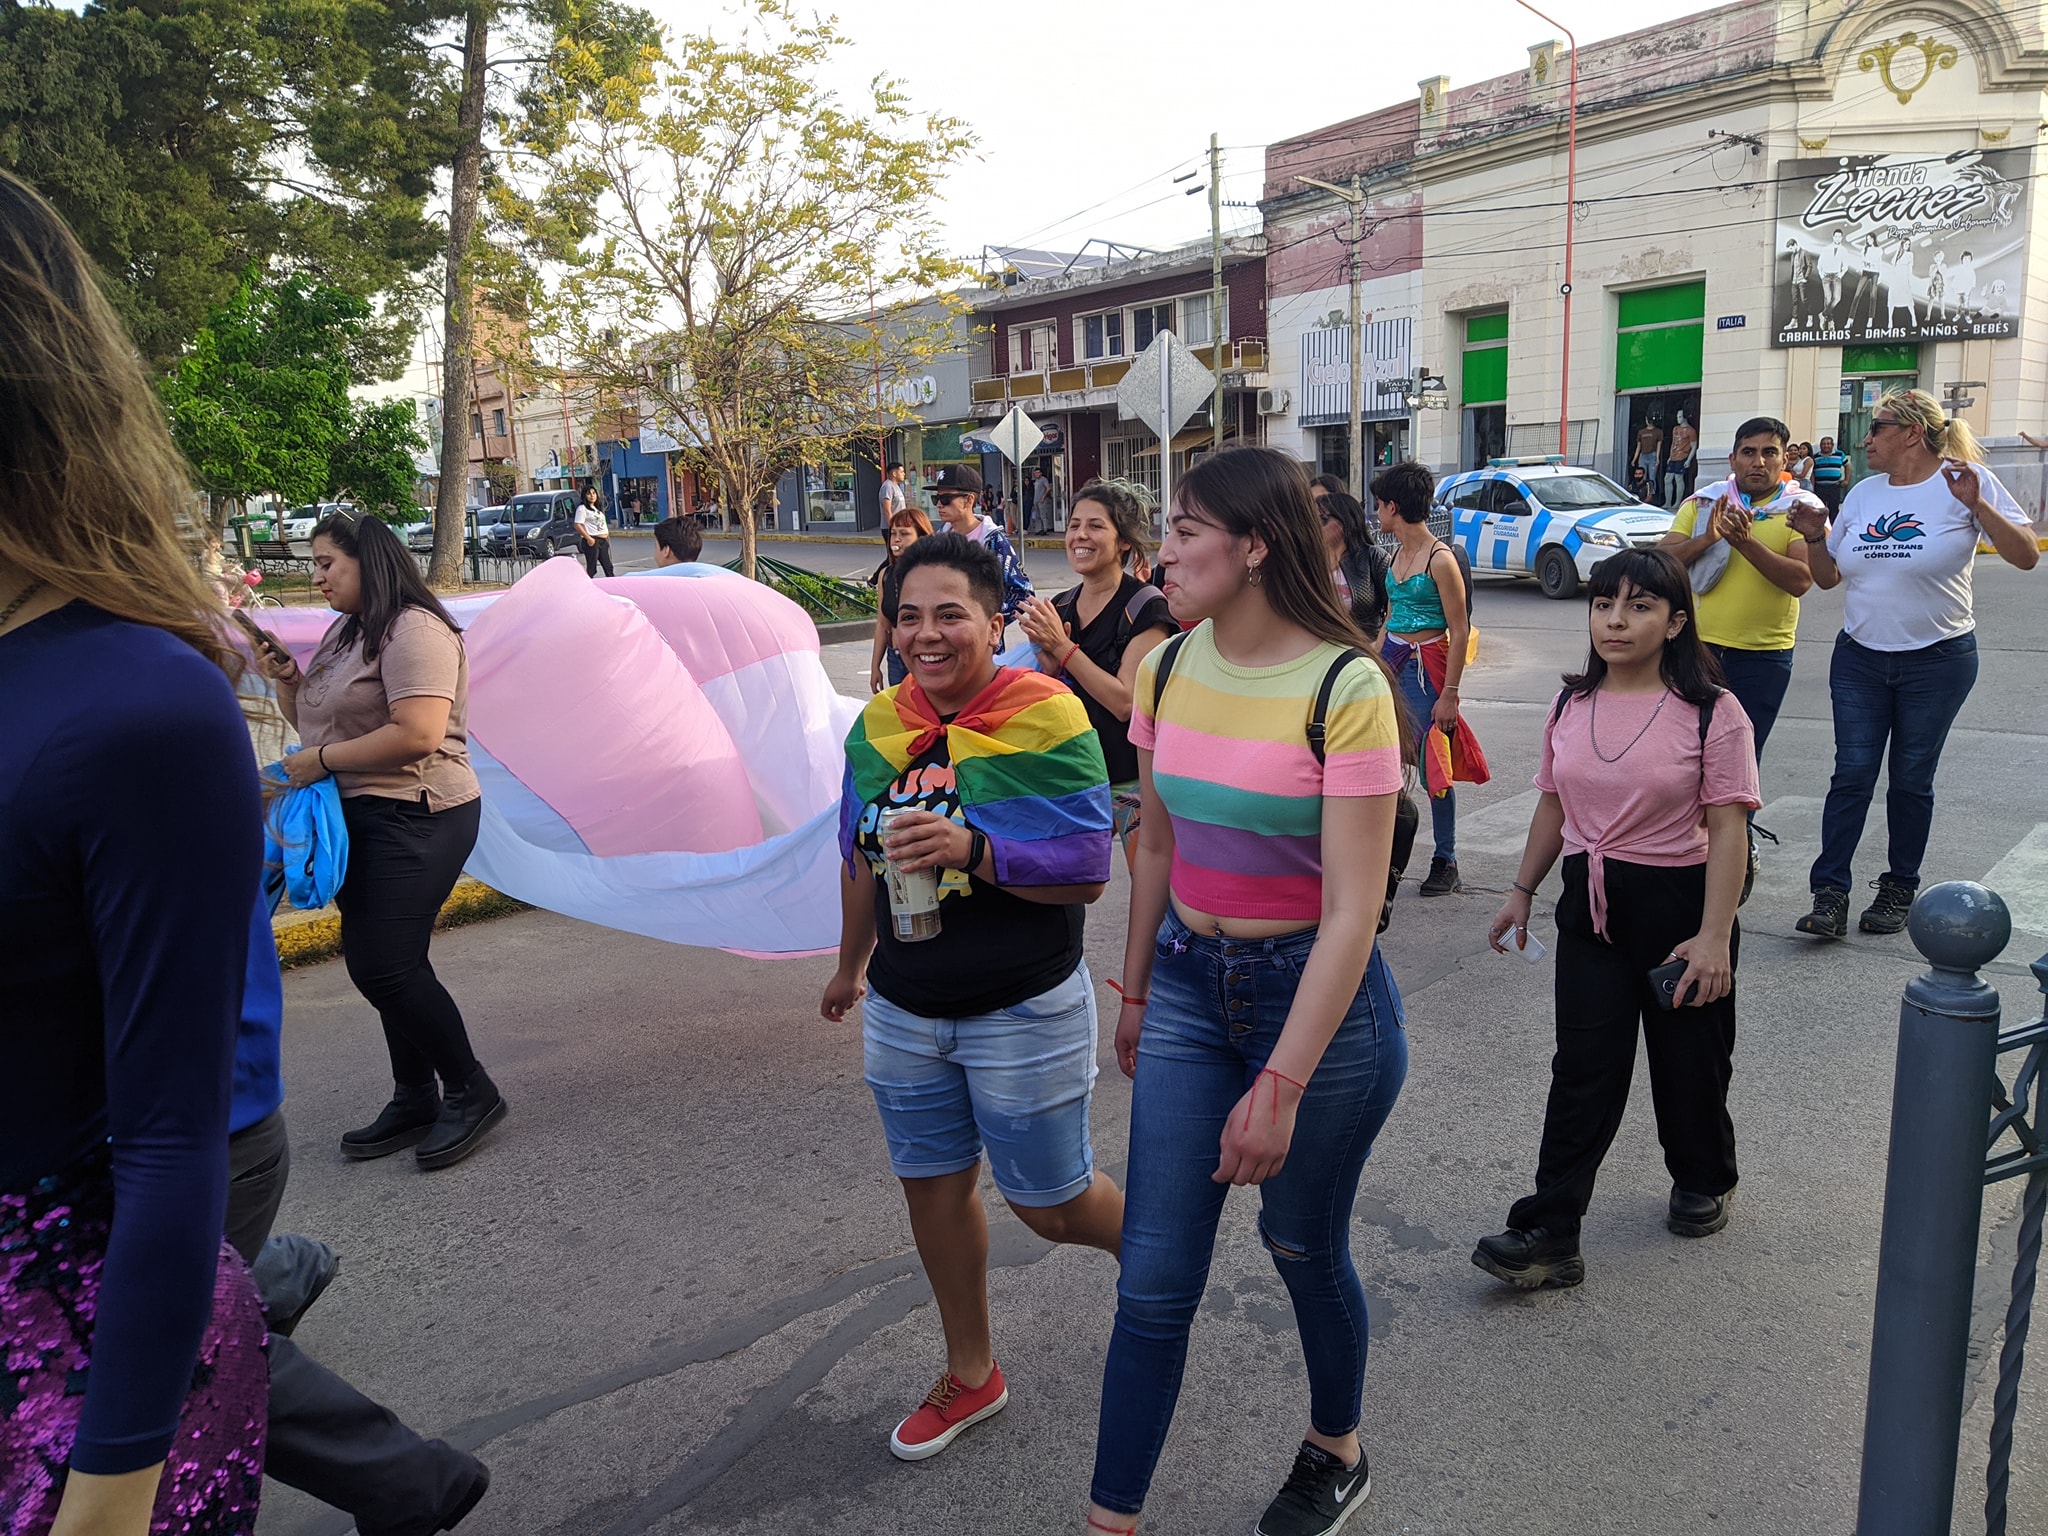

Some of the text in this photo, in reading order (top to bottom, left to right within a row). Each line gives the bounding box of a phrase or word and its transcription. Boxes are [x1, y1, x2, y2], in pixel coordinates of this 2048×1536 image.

[1855, 163, 1928, 188] Tienda
[1803, 169, 1986, 228] Leones
[1719, 316, 1743, 328] ITALIA
[1779, 330, 1851, 342] CABALLEROS
[1865, 327, 1906, 339] DAMAS
[1920, 323, 1959, 336] NIÑOS
[1973, 320, 2009, 334] BEBÉS
[1308, 346, 1404, 387] Cielo Azul
[1384, 380, 1410, 388] ITALIA
[1493, 524, 1518, 532] SEGURIDAD
[1493, 530, 1520, 538] CIUDADANA
[1852, 544, 1889, 552] CENTRO
[1864, 550, 1912, 559] CÓRDOBA
